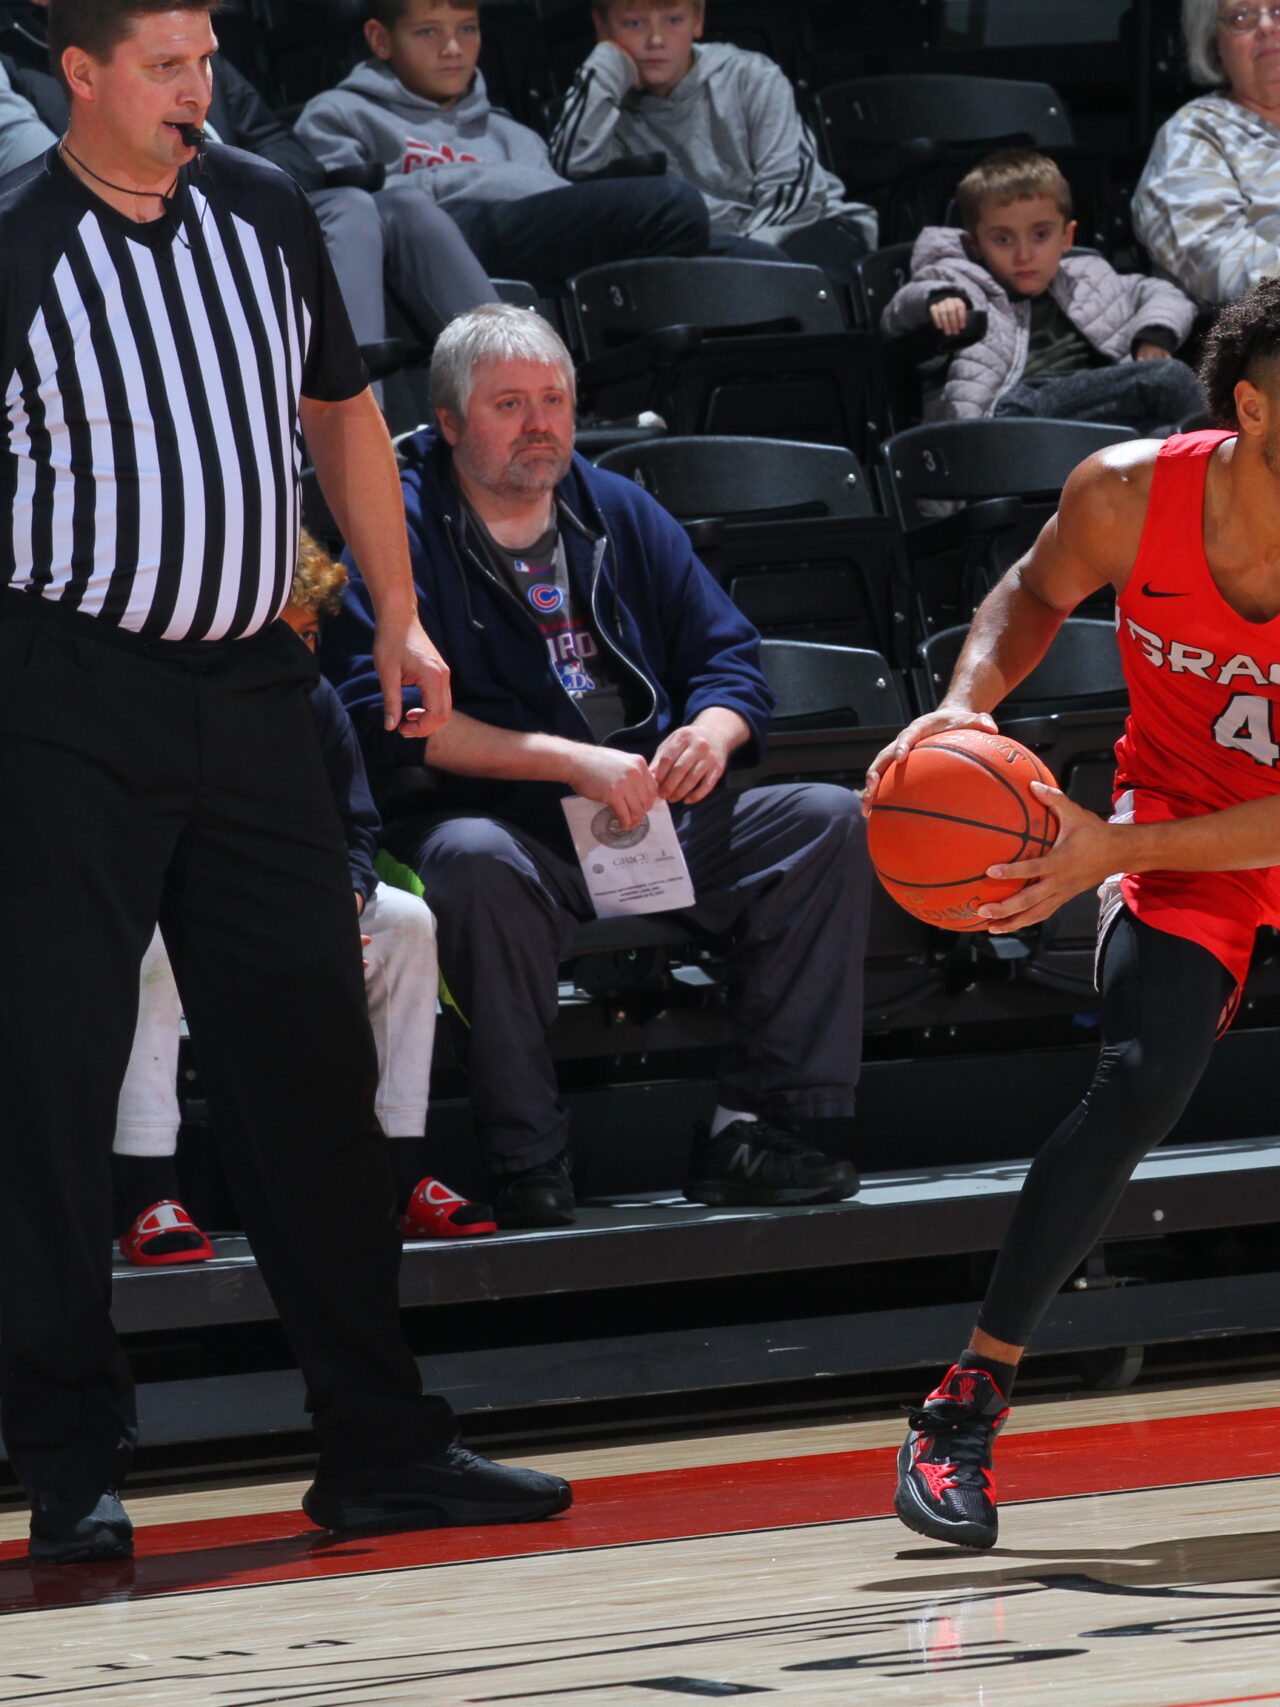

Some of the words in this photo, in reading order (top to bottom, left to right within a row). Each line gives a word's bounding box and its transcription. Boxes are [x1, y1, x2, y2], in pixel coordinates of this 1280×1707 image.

[852, 100, 865, 121] 1
[609, 285, 625, 307] 3
[922, 448, 937, 473] 3
